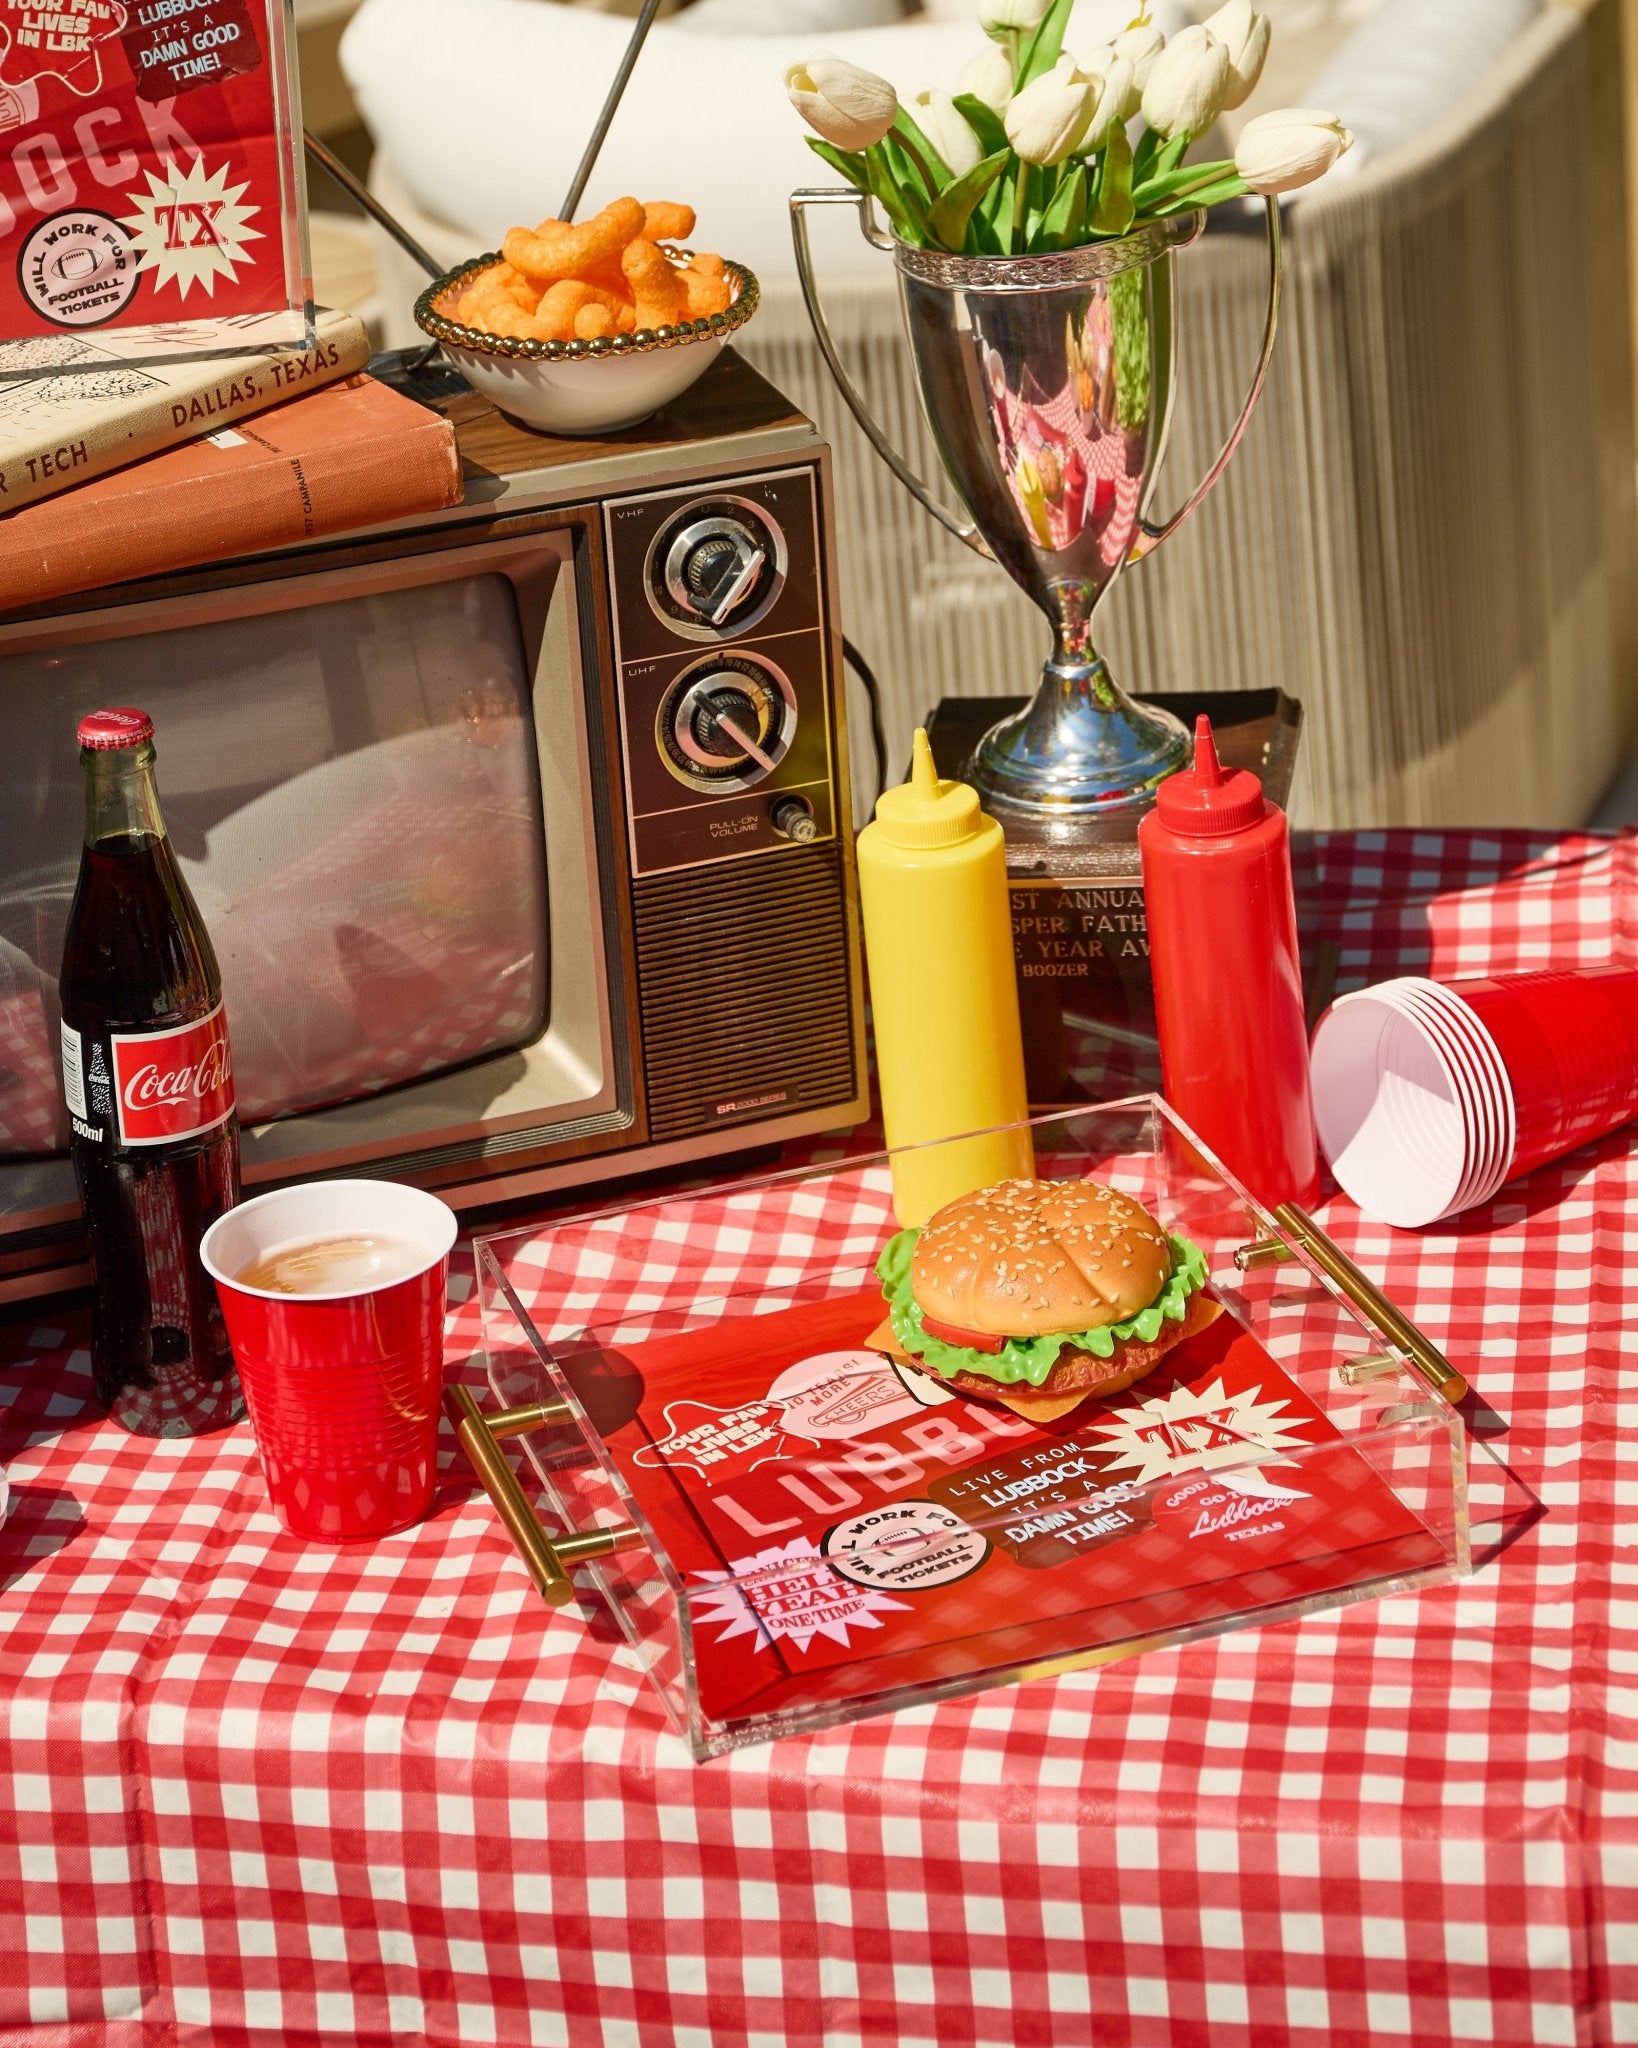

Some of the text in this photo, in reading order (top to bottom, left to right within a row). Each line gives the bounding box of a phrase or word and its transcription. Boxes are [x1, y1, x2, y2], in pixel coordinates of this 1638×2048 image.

[7, 0, 110, 19] YOUR FAV
[22, 11, 90, 34] LIVES
[138, 0, 220, 25] LUBBO
[17, 28, 92, 51] IN LBK
[152, 14, 213, 42] IT'S A
[140, 23, 240, 68] DAMN GOOD
[168, 52, 222, 81] TIME!
[0, 96, 206, 237] OCK
[154, 200, 229, 250] TX
[32, 223, 126, 298] WILL WORK FOR
[48, 278, 124, 305] FOOTBALL
[58, 291, 120, 315] TICKETS
[25, 441, 88, 482] TECH
[171, 376, 263, 428] DALLAS,
[271, 343, 339, 388] TEXAS
[290, 459, 313, 514] CAMPANILE
[616, 508, 645, 519] VHF
[628, 665, 657, 677] UHF
[710, 815, 758, 830] PULL-ON
[711, 823, 758, 838] VOLUME
[1010, 890, 1145, 909] ST ANNUA
[1011, 914, 1147, 934] SPER FATH
[1038, 940, 1104, 958] YEAR
[1022, 963, 1089, 977] BOOZER
[124, 1036, 231, 1111] Coca-Cola
[72, 1116, 104, 1142] 500ml
[810, 1375, 851, 1407] MORE
[825, 1385, 896, 1421] CHEERS
[658, 1406, 769, 1455] YOUR FAV
[686, 1420, 762, 1456] LIVES
[695, 1426, 779, 1465] IN LBK
[1134, 1406, 1263, 1460] TX
[949, 1442, 1081, 1497] LIVE FROM
[980, 1456, 1097, 1508] LUBBOCK
[1011, 1480, 1098, 1514] IT'S A
[1166, 1480, 1208, 1507] GOOD
[1200, 1494, 1226, 1506] GO
[849, 1509, 917, 1535] WORK
[1004, 1480, 1146, 1543] DAMN GOOD
[1054, 1509, 1135, 1545] TIME!
[1188, 1497, 1294, 1539] Lubbock
[1224, 1521, 1286, 1541] TEXAS
[841, 1540, 875, 1576] WIL
[877, 1543, 973, 1579] FOOTBALL
[895, 1553, 973, 1584] TICKETS
[752, 1581, 872, 1619] YEAH
[768, 1600, 866, 1629] ONE TIME
